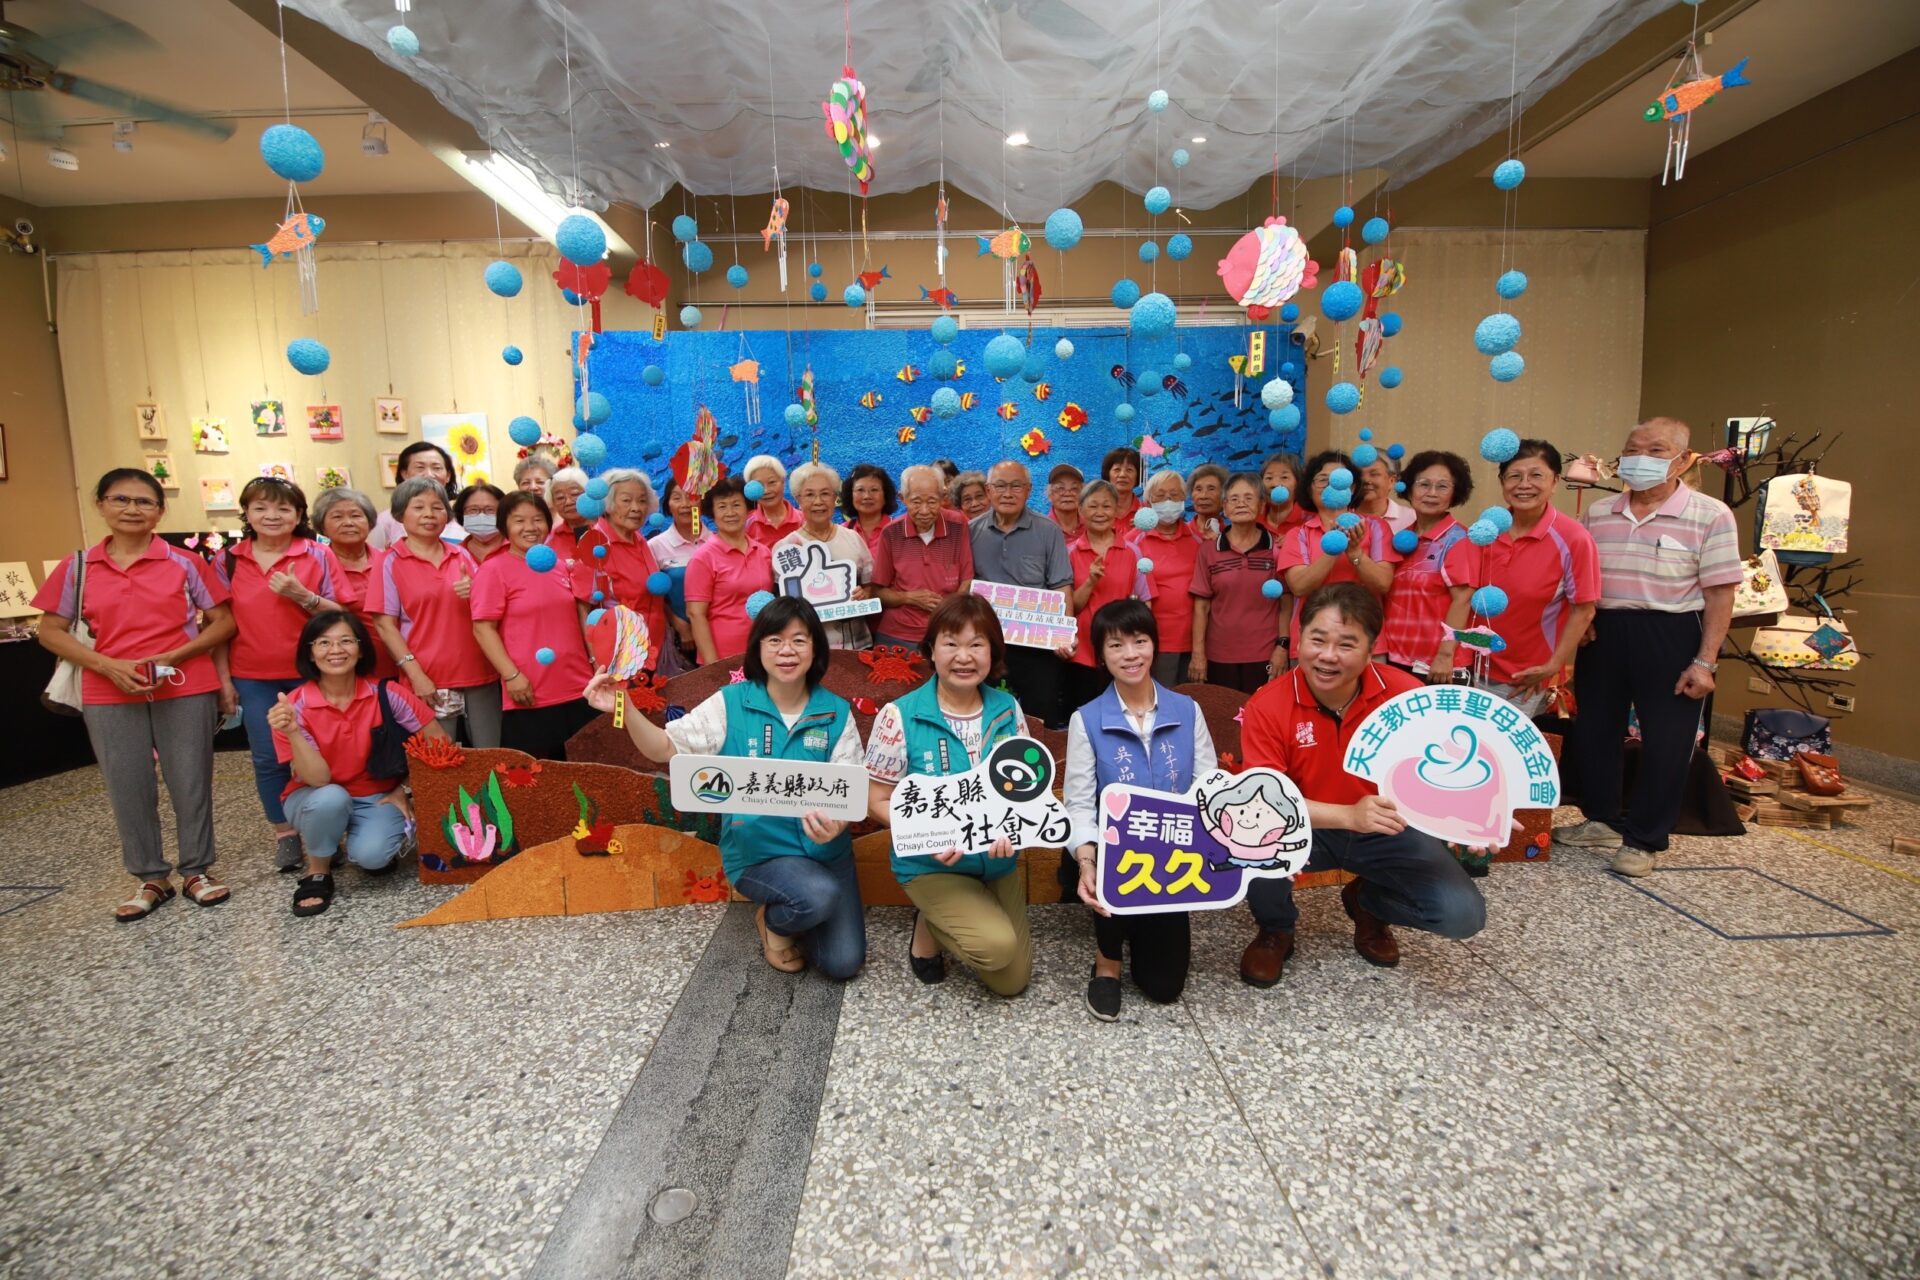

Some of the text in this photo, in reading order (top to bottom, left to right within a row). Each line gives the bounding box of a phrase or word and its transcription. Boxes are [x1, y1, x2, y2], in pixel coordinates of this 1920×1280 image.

[777, 546, 805, 574] 讚
[1347, 688, 1557, 806] 天主教中華聖母基金會
[737, 771, 850, 798] 嘉義縣政府
[741, 796, 849, 809] Chiayi County Government
[894, 774, 987, 821] 嘉義縣
[896, 839, 957, 851] Chiayi County
[960, 802, 1072, 851] 社會局
[1127, 809, 1195, 846] 幸福
[1116, 849, 1211, 896] 久久
